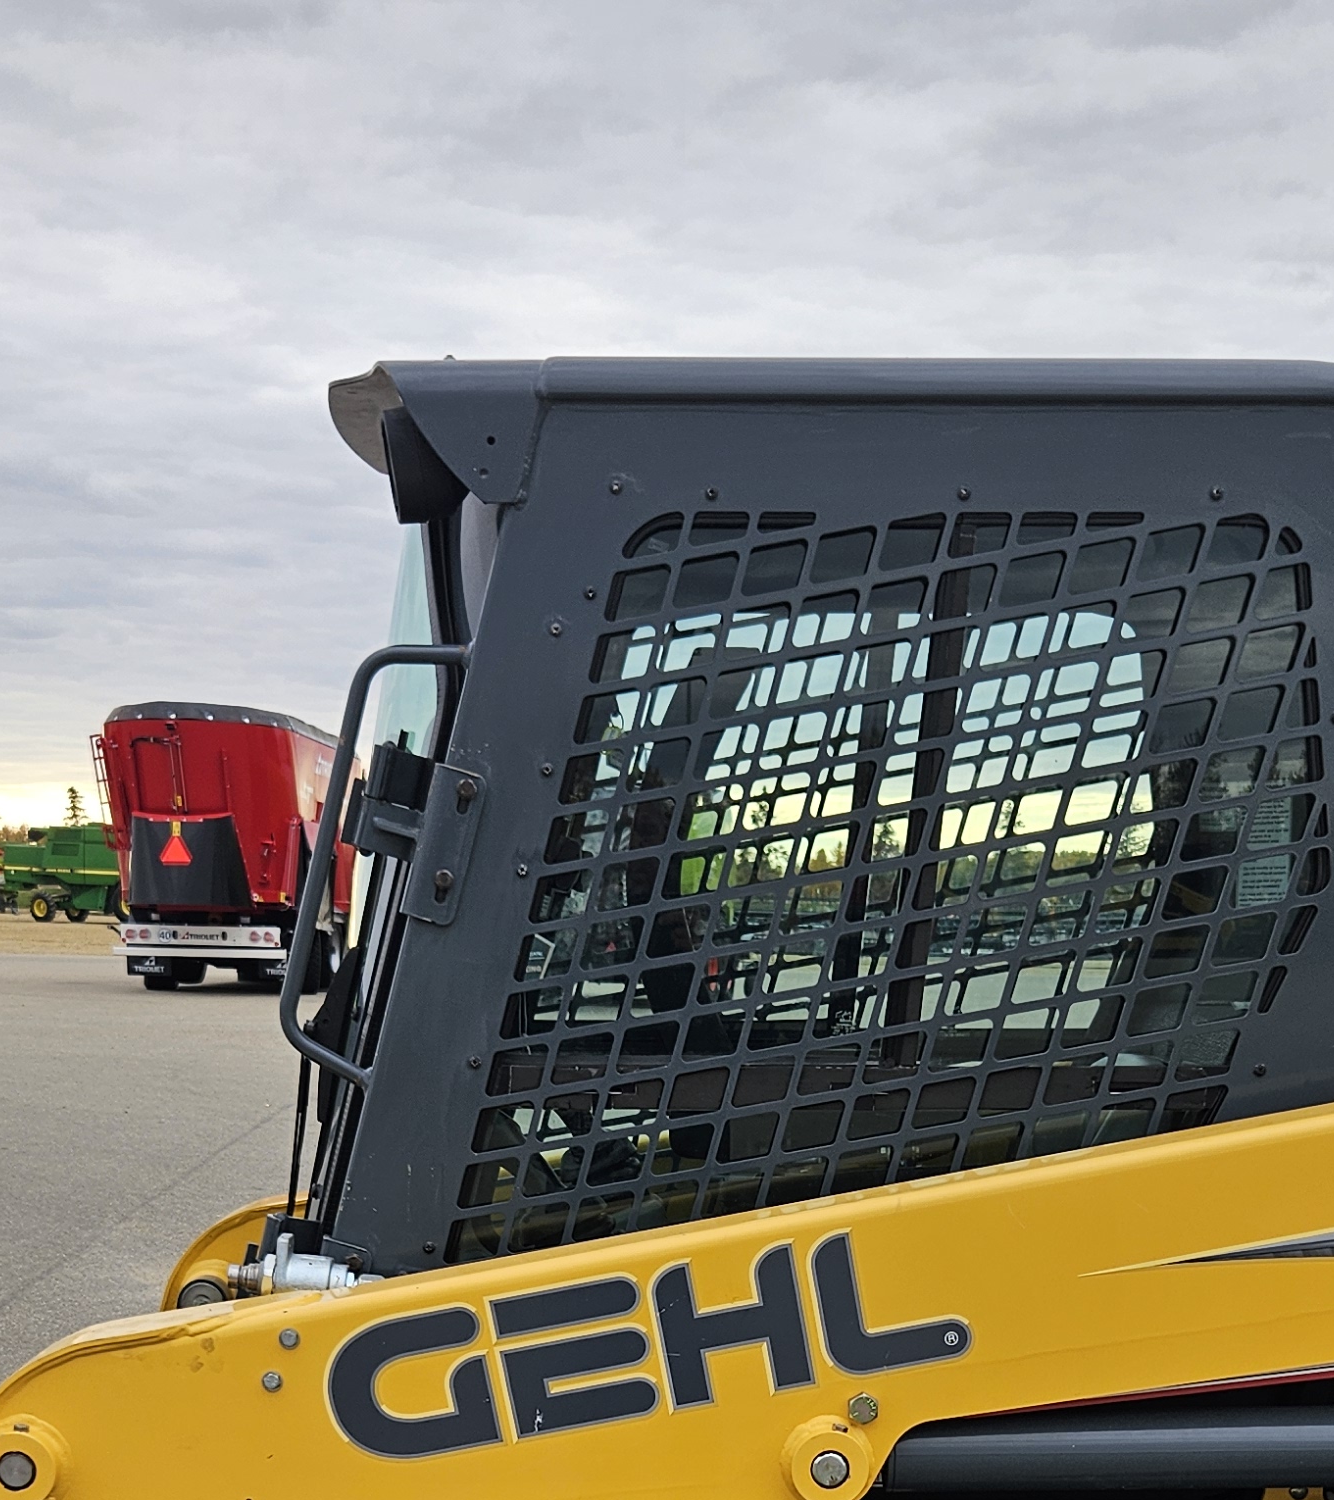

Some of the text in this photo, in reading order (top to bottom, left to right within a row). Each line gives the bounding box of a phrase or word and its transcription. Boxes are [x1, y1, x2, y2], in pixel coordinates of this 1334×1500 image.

[159, 931, 171, 939] 40
[134, 965, 165, 973] TRIOLIET
[324, 1226, 973, 1460] GEHL
